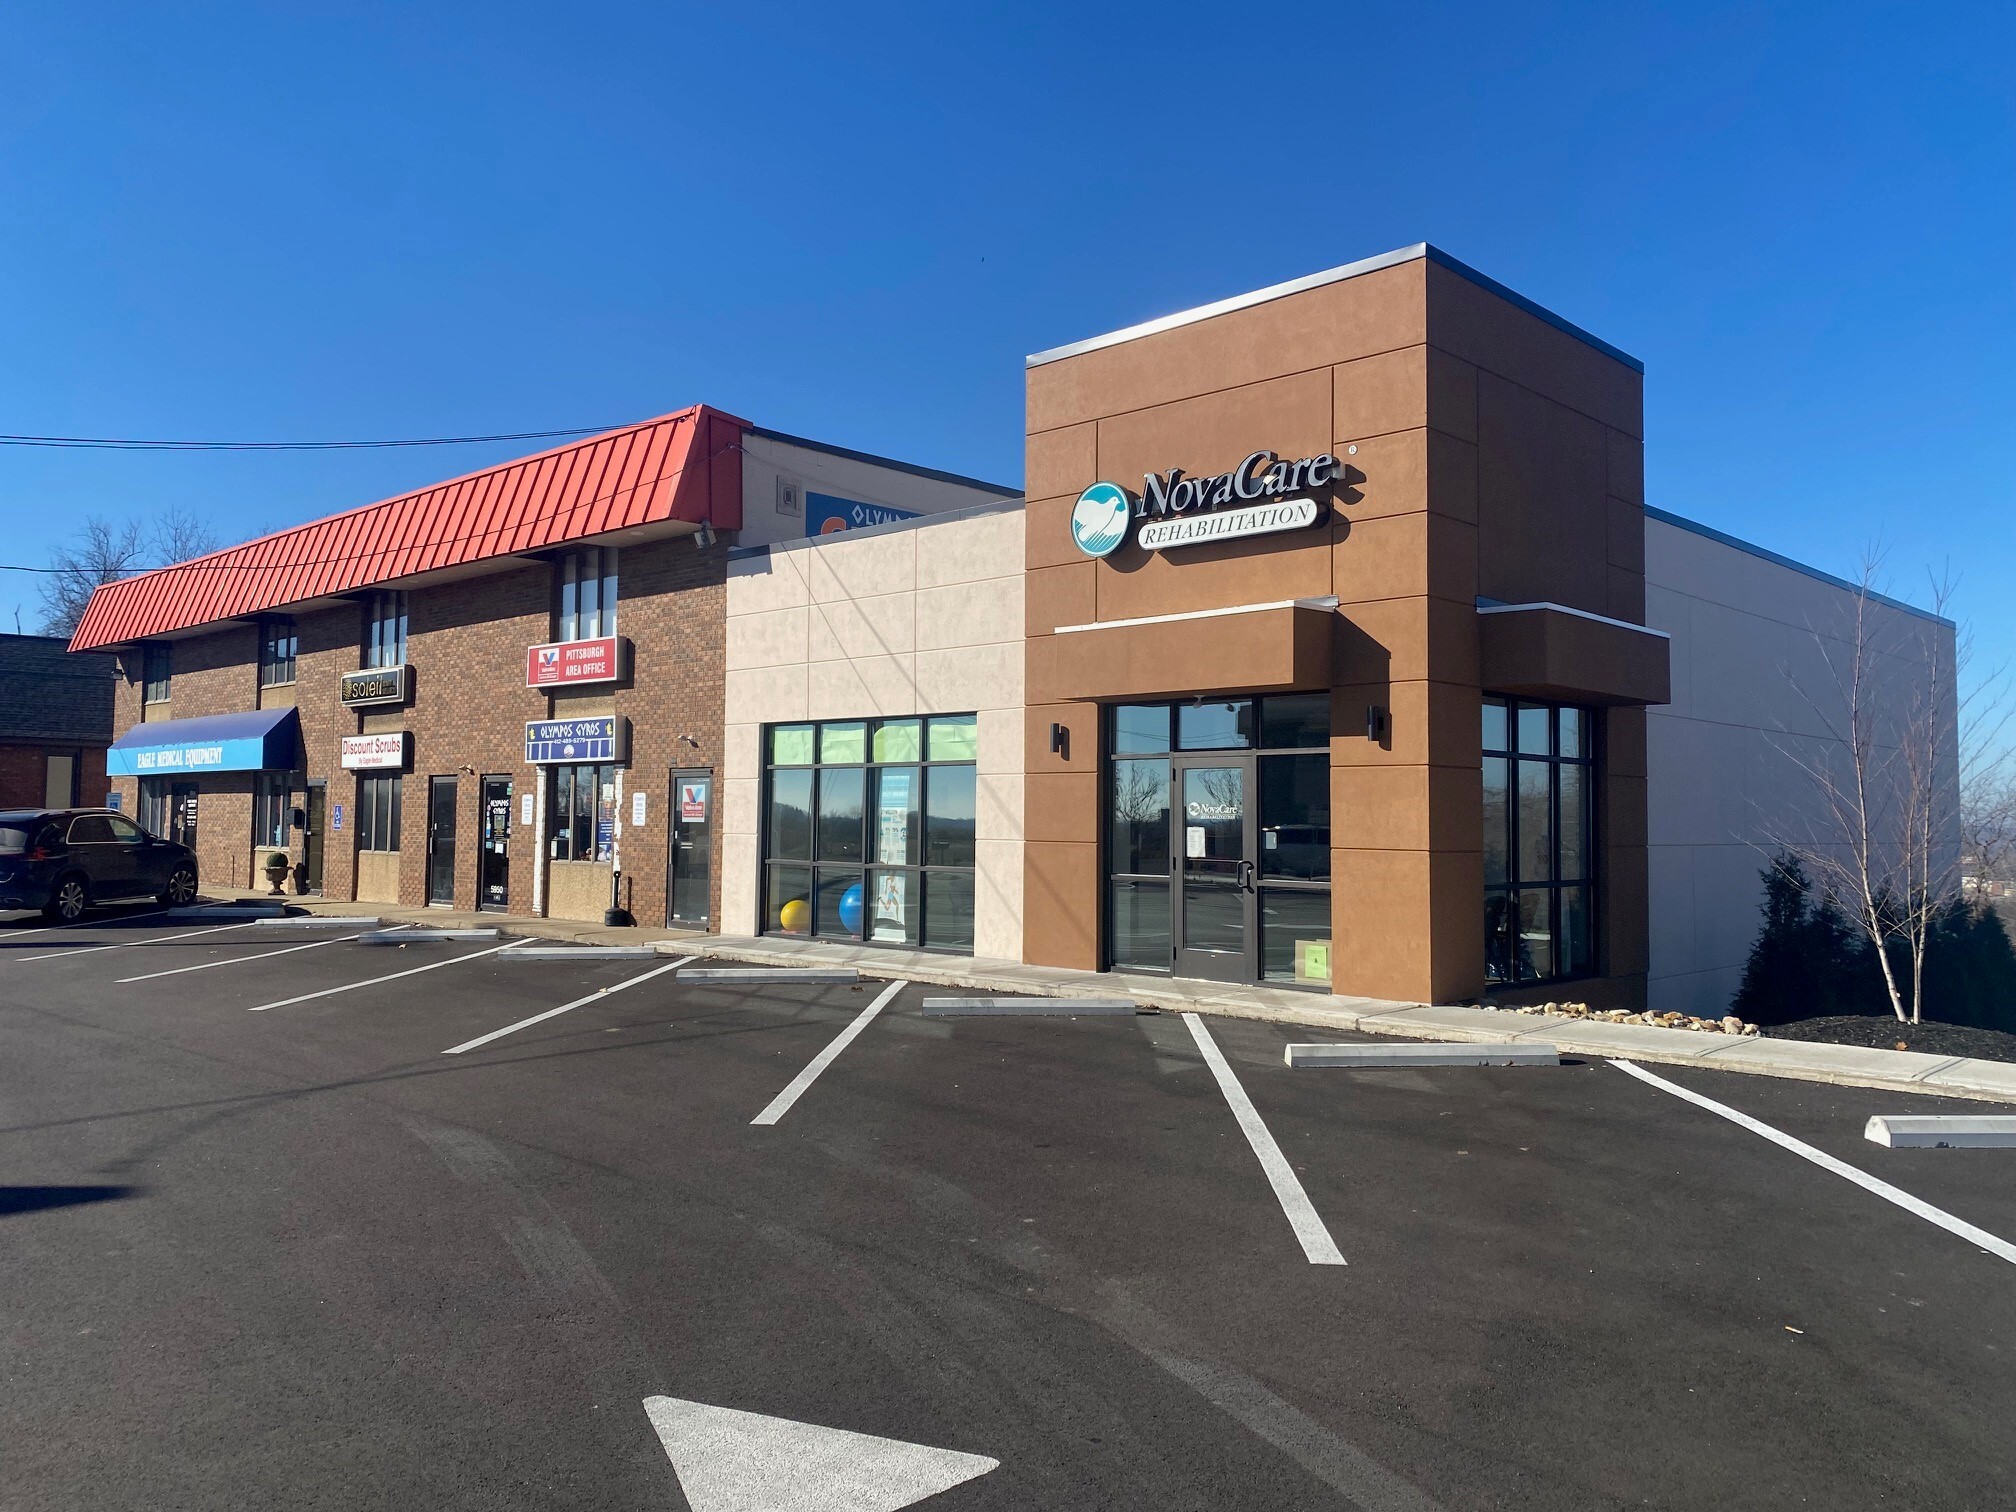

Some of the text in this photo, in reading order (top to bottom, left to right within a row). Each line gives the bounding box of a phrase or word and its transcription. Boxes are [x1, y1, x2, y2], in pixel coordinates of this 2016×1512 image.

[1135, 450, 1333, 518] NovaCare
[1143, 503, 1311, 545] REHABILITATION
[565, 646, 605, 661] PITTSBURGH
[565, 664, 582, 677] AREA
[582, 662, 606, 675] OFFICE
[352, 674, 382, 698] soleil
[540, 722, 600, 739] OLYMPOS GYROS
[343, 737, 401, 755] Discount Scrubs
[137, 747, 223, 769] EAGLE MEDICAL EQUIPMENT
[1200, 803, 1238, 814] NovaCare
